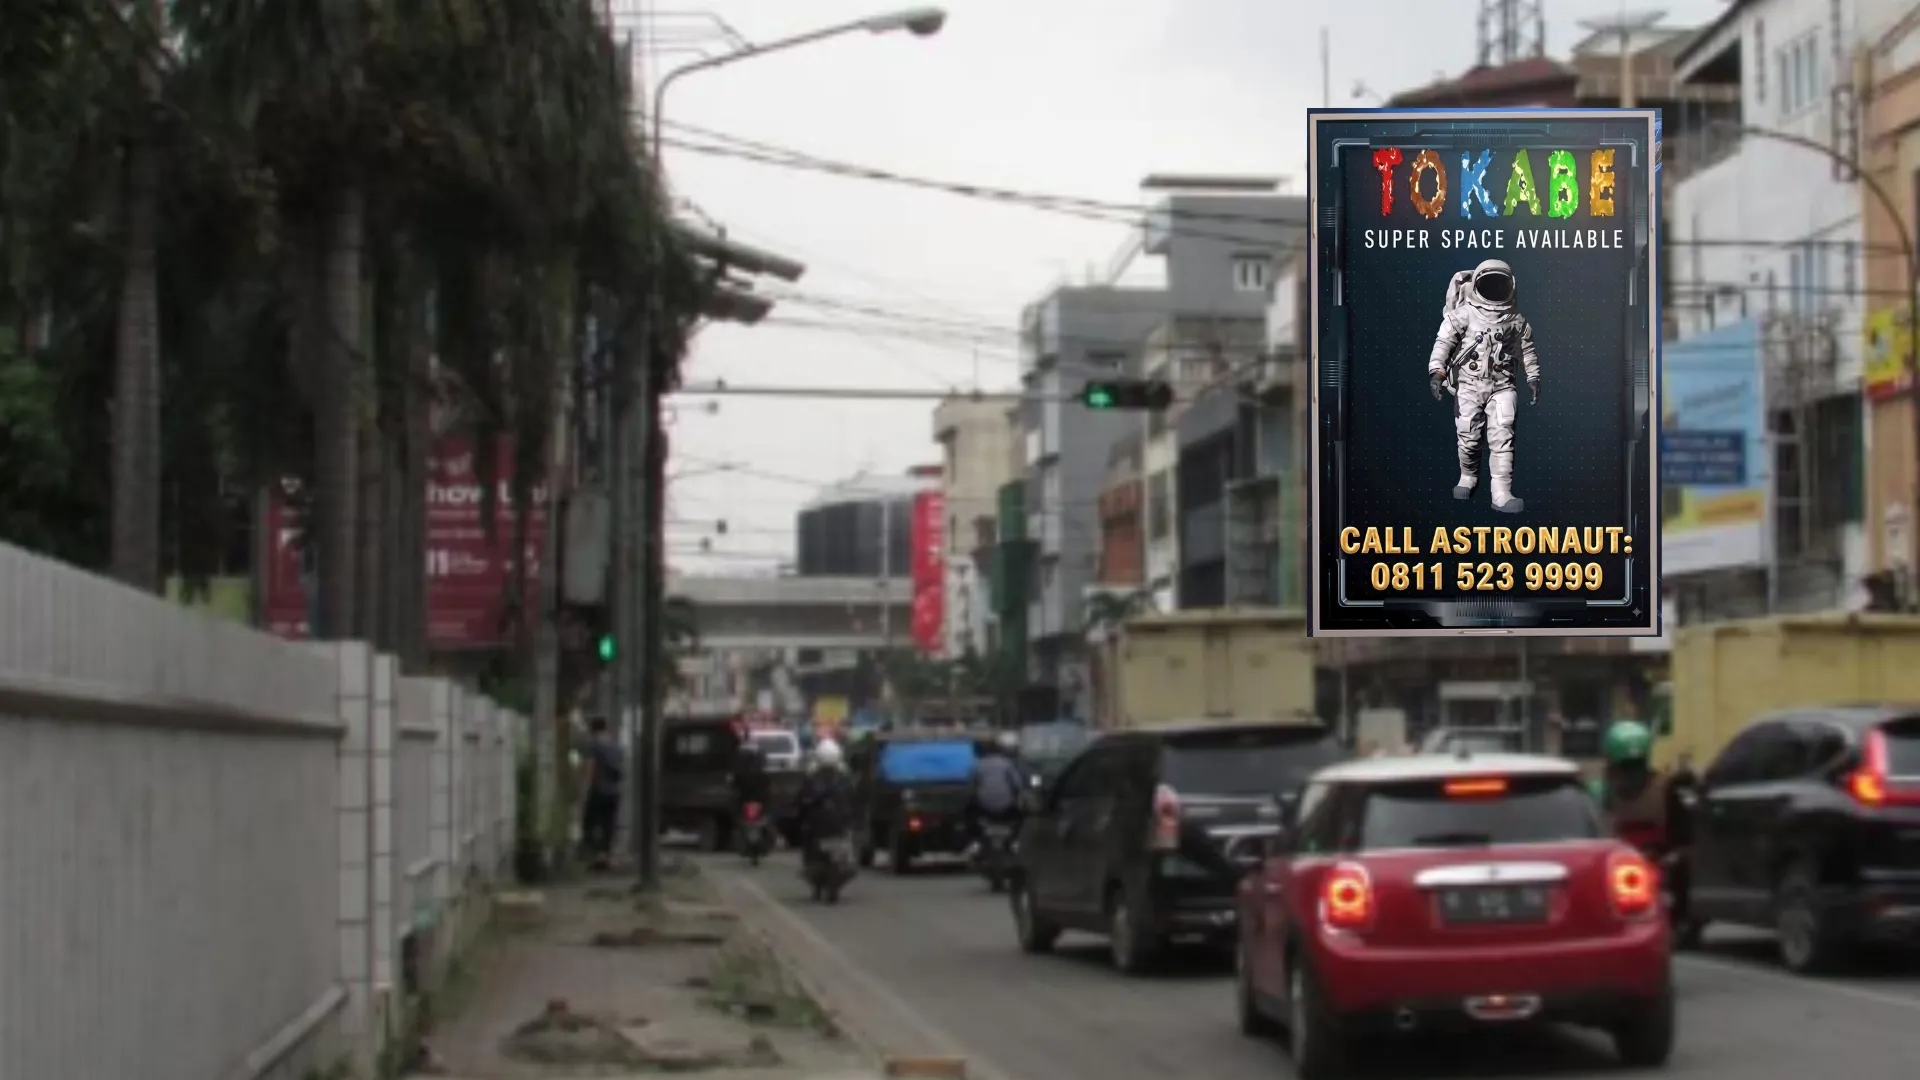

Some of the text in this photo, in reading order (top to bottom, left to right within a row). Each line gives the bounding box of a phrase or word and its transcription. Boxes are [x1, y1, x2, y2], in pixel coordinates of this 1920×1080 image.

[1372, 148, 1616, 219] TOKABE
[1364, 229, 1624, 249] SUPER SPACE AVAILABLE
[1339, 526, 1634, 554] CALL ASTRONAUT:
[1370, 562, 1604, 591] 0811 523 9999
